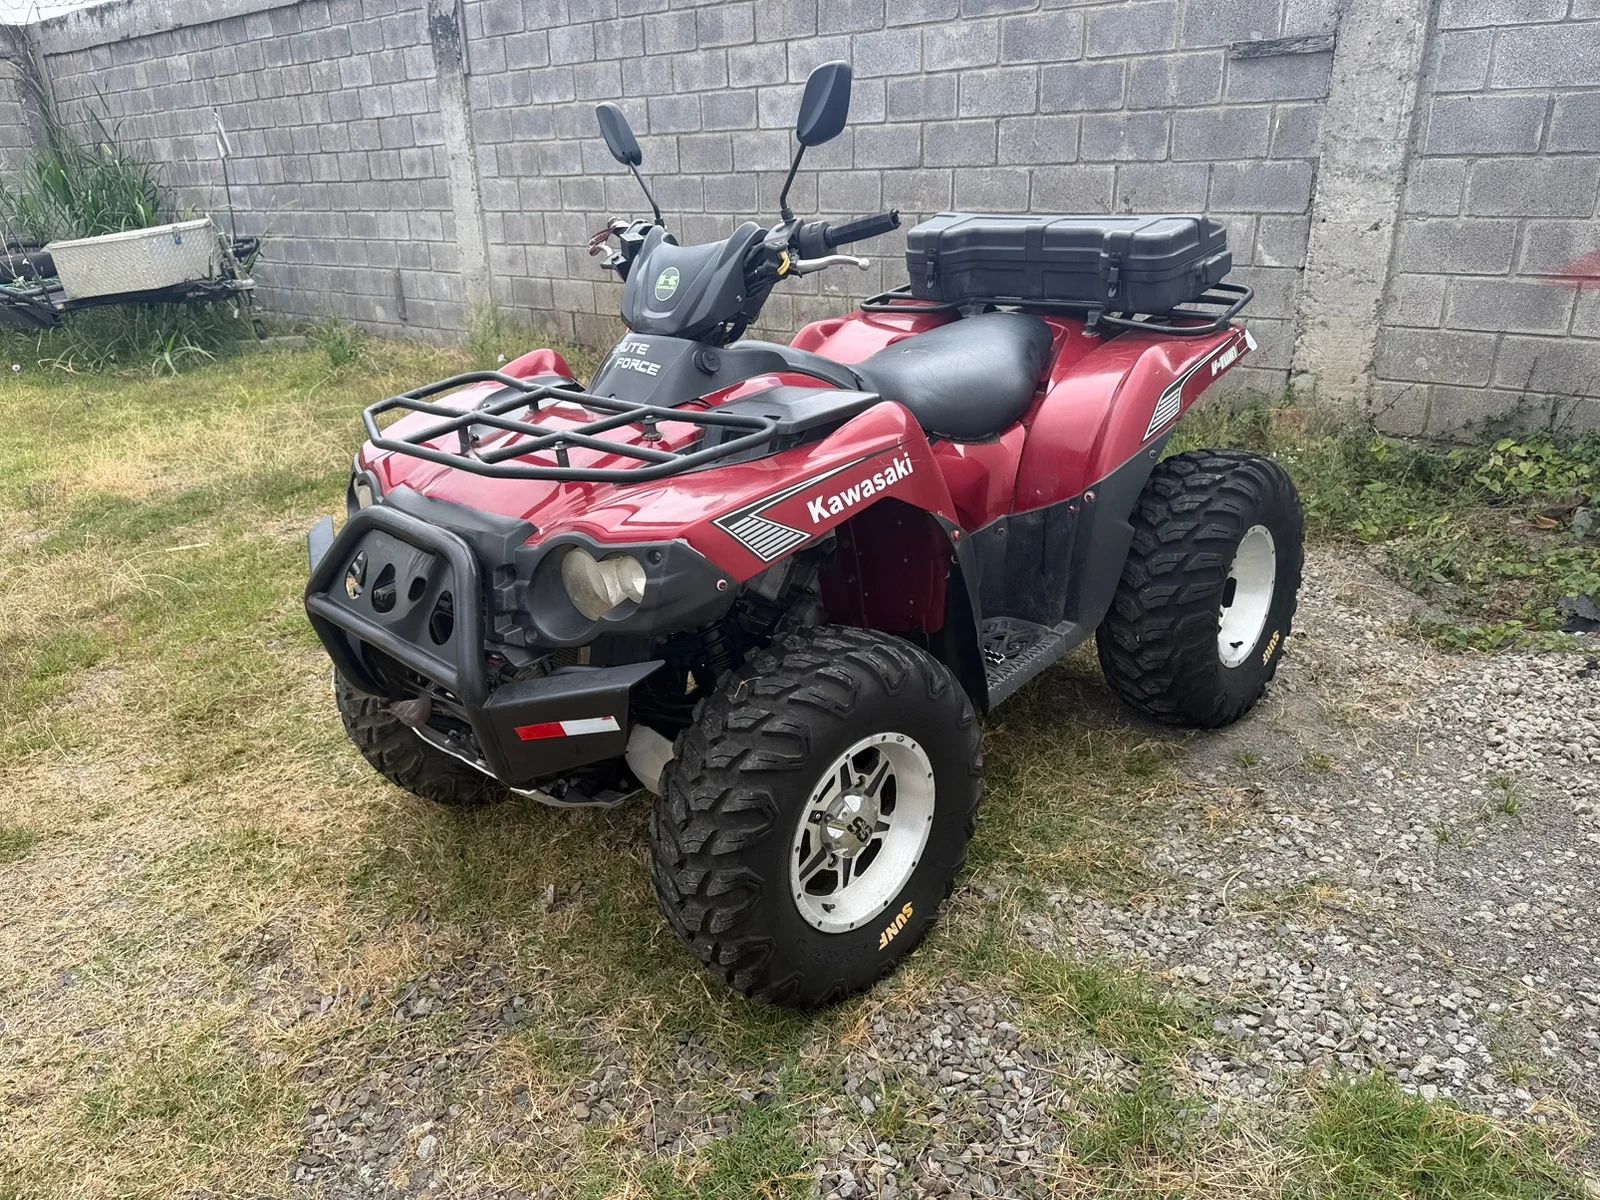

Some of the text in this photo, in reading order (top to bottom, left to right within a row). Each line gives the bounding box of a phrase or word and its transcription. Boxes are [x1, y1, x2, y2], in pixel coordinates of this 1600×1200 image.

[614, 357, 661, 377] FORCE
[806, 452, 914, 524] Kawasaki
[878, 900, 914, 952] SUNF
